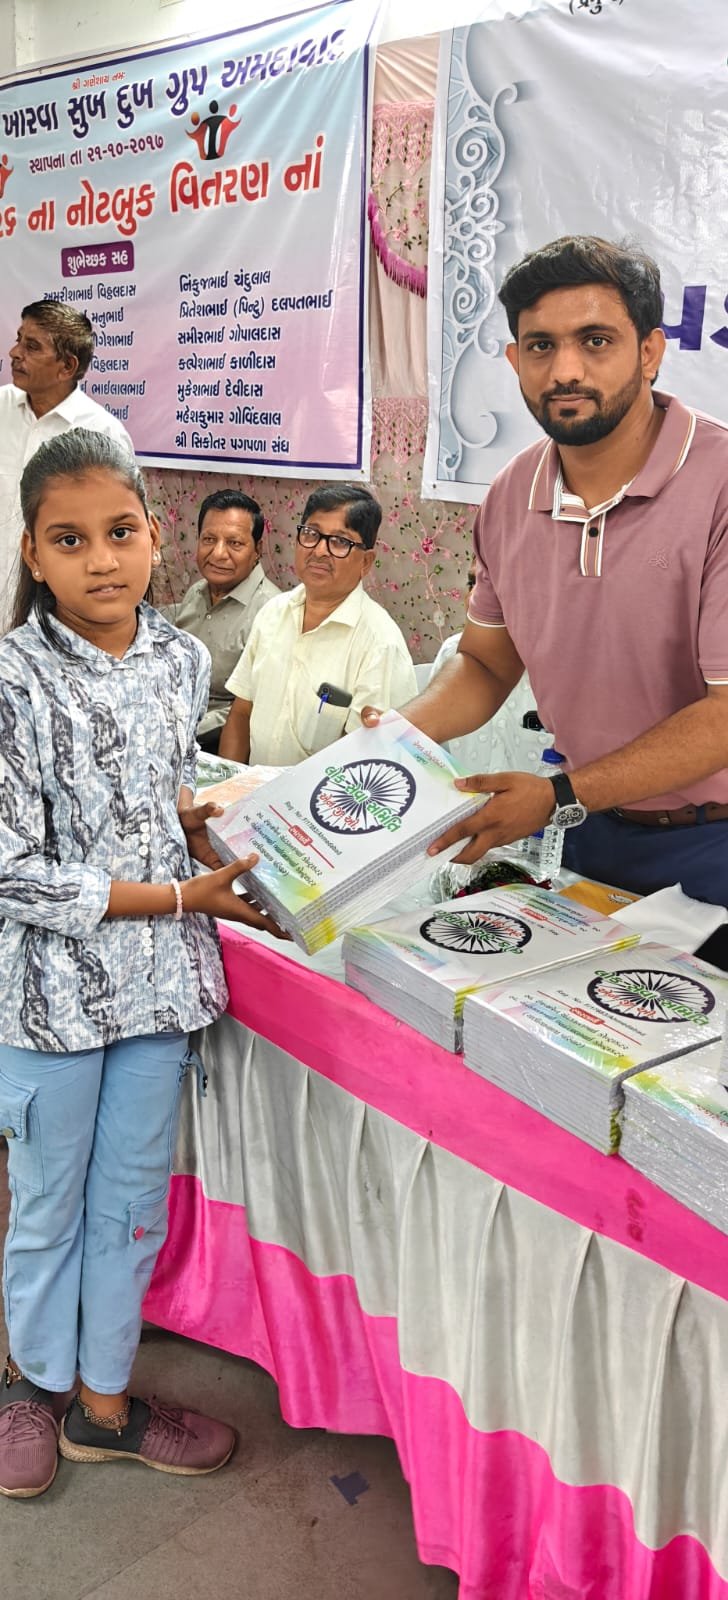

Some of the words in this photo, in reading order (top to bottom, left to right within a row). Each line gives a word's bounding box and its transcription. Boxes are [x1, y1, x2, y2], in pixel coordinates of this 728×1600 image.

[72, 78, 80, 90] શ્રી
[2, 102, 59, 138] ખારવા
[67, 91, 107, 138] સુખ
[116, 78, 154, 129] દુખ
[29, 153, 65, 174] સ્થાપના
[70, 150, 82, 165] તા
[87, 134, 164, 162] ૨૧-૧૦-૨૦૧૭
[28, 201, 54, 231] ના
[66, 180, 156, 236] નોટબુક
[170, 161, 269, 213] વિતરણ
[283, 135, 324, 191] નાં
[111, 249, 129, 265] સહ
[234, 269, 271, 292] ચંદુલાલ
[179, 298, 228, 318] પ્રિતેશભાઈ
[271, 290, 334, 312] દલપતભાઈ
[91, 306, 124, 328] મનુભાઈ
[178, 326, 226, 344] સમીરભાઈ
[229, 324, 281, 342] ગોપાલદાસ
[178, 353, 226, 370] કલ્પેશભાઈ
[230, 351, 276, 369] કાળીદાસ
[91, 380, 146, 395] ભાઈલાલભાઈ
[177, 379, 221, 402] મુકેશભાઈ
[225, 378, 263, 397] દેવીદાસ
[176, 405, 224, 429] મહેશકુમાર
[229, 406, 281, 426] ગોવિંદલાલ
[175, 431, 187, 448] શ્રી
[191, 432, 226, 450] સિકોતર
[230, 438, 266, 452] પગપળા
[367, 801, 402, 832] સમિતિ
